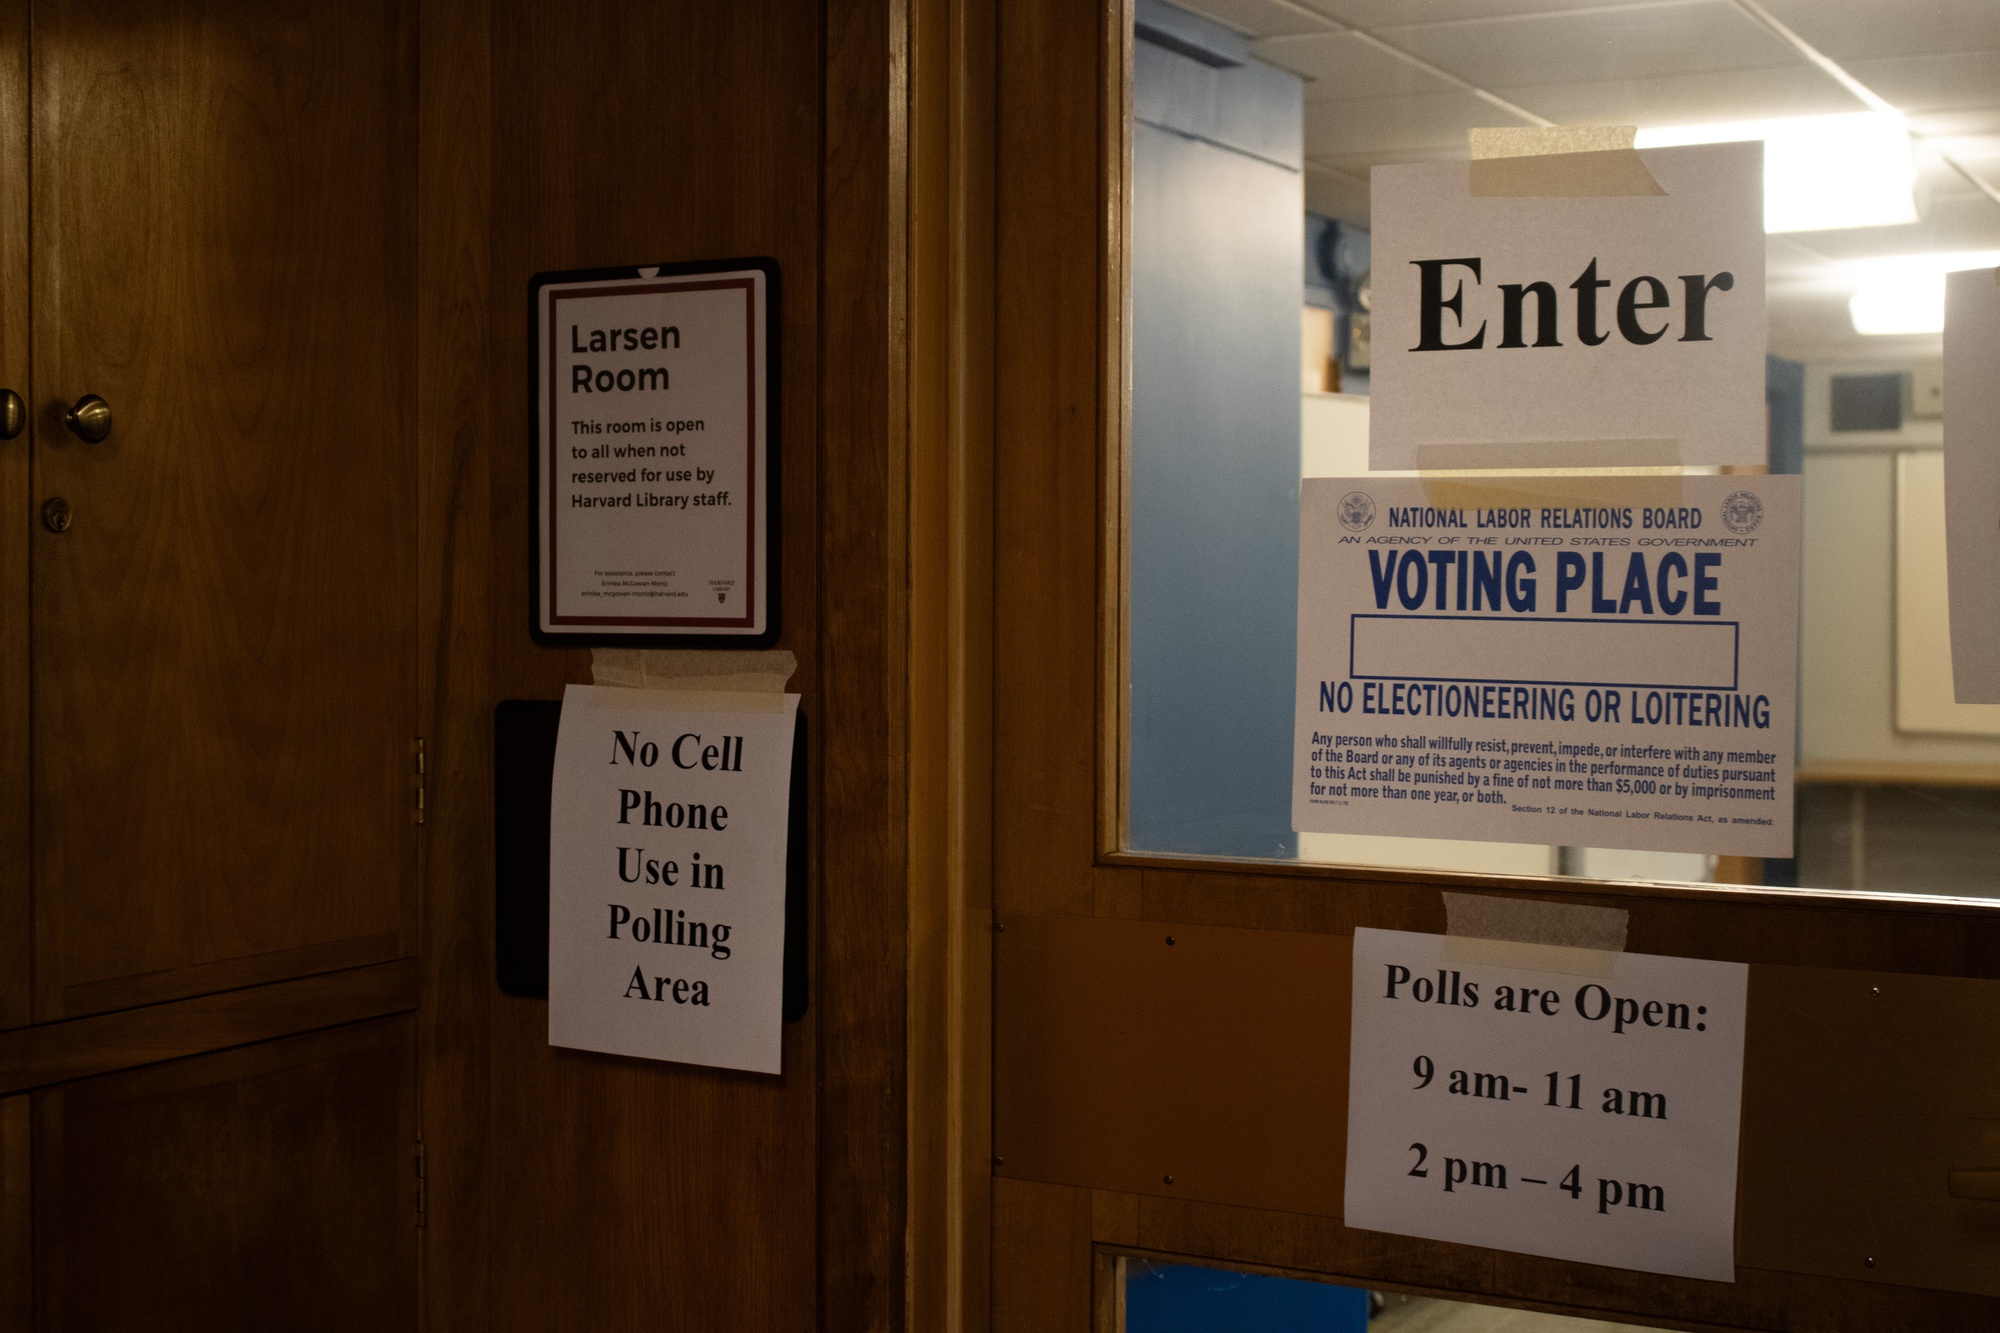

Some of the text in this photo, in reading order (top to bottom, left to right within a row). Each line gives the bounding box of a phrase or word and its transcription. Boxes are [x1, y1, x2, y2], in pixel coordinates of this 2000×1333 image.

[1408, 256, 1733, 352] Enter
[571, 324, 680, 353] Larsen
[572, 364, 669, 393] Room
[571, 418, 704, 435] This room is open
[571, 443, 685, 459] to all when not
[571, 466, 714, 484] reserved for use by
[571, 491, 731, 510] Harvard Library staff.
[1389, 507, 1702, 529] NATIONAL LABOR RELATIONS BOARD
[1338, 535, 1759, 547] AN AGENCY OF THE UNITED STATES GOVERNMENT
[1368, 549, 1721, 616] VOTING PLACE
[1319, 681, 1770, 729] NO ELECTIONEERING OR LOITERING
[609, 730, 743, 772] No Cell
[1311, 731, 1777, 765] Any person who shall willfully resist, prevent, impede, or interfere with any member
[1311, 748, 1776, 784] of the Board or any of its agents or agencies in the performance of duties pursuant
[1310, 765, 1776, 801] to this Act shall be punished by a fine of not more than $5,000 or by imprisonment
[1310, 782, 1507, 804] for not more than one year, or both.
[616, 788, 728, 831] Phone
[1511, 804, 1542, 813] Section
[1546, 806, 1555, 814] 12
[1558, 806, 1568, 814] of
[1587, 808, 1622, 817] National
[1625, 810, 1650, 819] Labor
[1653, 811, 1694, 822] Relations
[1717, 816, 1729, 824] as
[616, 846, 724, 890] Use in
[607, 904, 732, 960] Polling
[623, 964, 710, 1006] Area
[1384, 964, 1707, 1034] Polls are Open:
[1413, 1055, 1434, 1089] 9
[1544, 1071, 1583, 1110] 11
[1601, 1088, 1667, 1120] am
[1407, 1142, 1428, 1178] 2
[1443, 1157, 1508, 1192] pm
[1559, 1164, 1582, 1199] 4
[1597, 1178, 1665, 1214] pm
